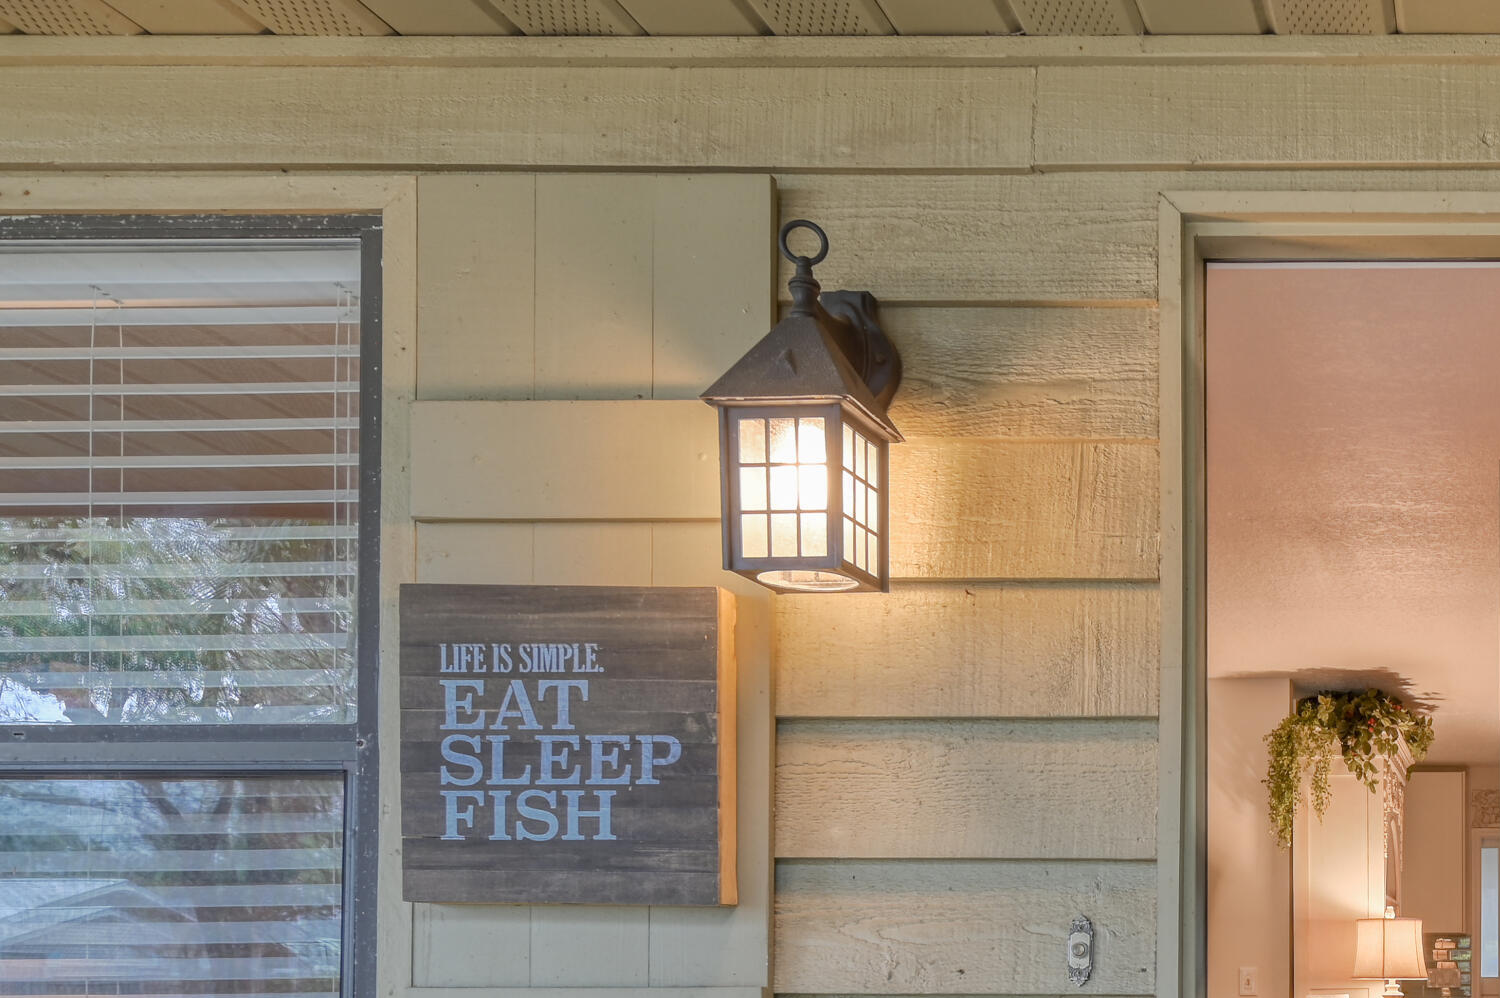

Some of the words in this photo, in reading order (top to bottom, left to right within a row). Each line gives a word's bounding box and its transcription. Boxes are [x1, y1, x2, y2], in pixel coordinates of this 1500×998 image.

[439, 643, 487, 673] LIFE
[492, 643, 513, 673] IS
[519, 643, 604, 673] SIMPLE.
[439, 679, 588, 730] EAT
[440, 734, 682, 786] SLEEP
[440, 789, 617, 841] FISH
